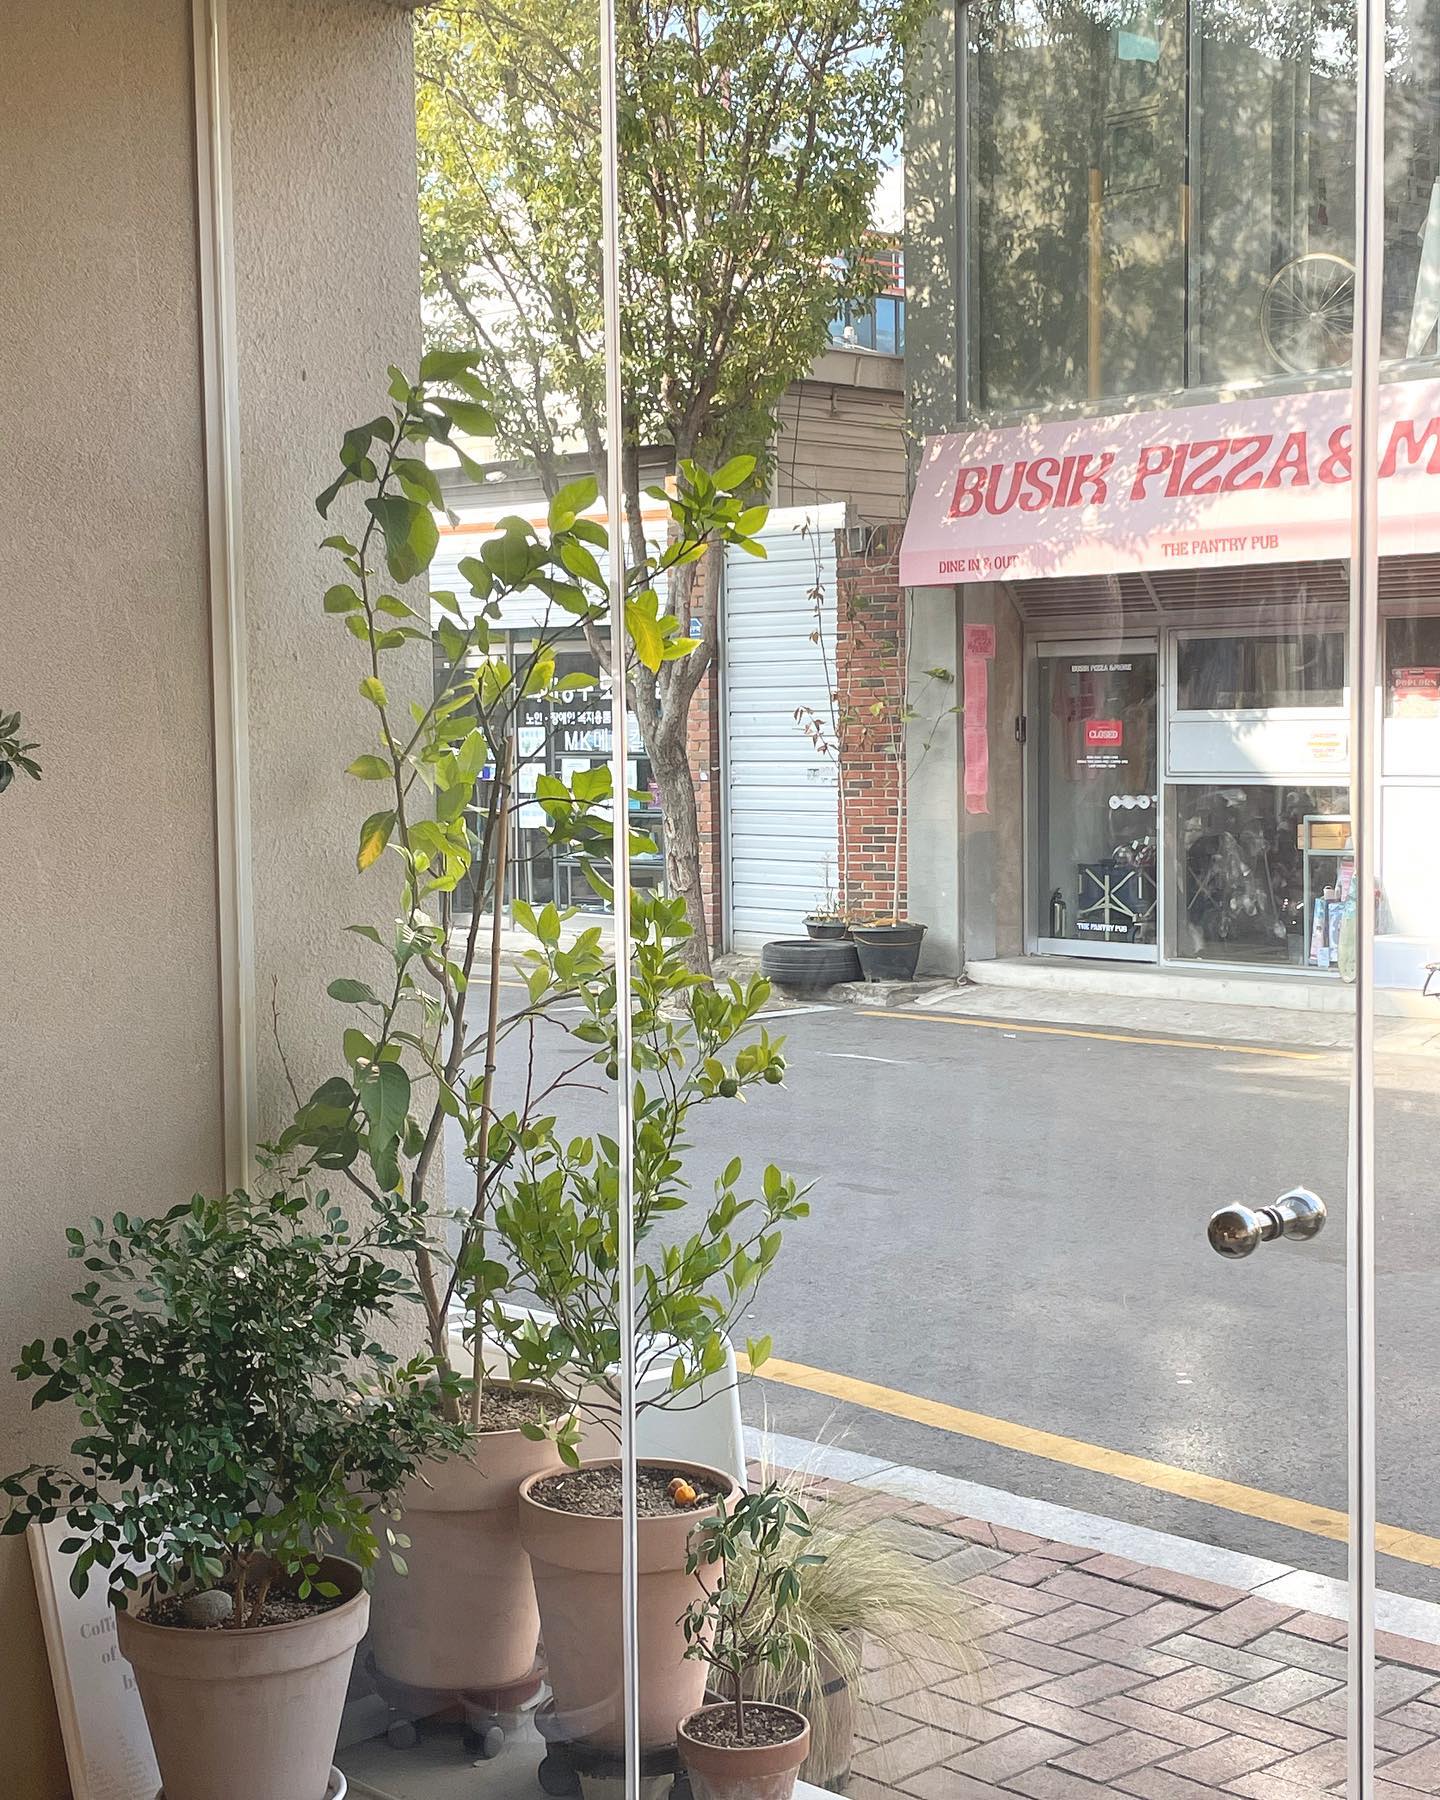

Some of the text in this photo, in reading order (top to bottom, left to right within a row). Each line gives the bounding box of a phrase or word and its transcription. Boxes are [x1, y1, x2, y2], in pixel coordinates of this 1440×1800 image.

[950, 453, 1115, 518] BUSIK
[1130, 431, 1310, 501] PIZZA
[1161, 534, 1279, 557] THE PANTRY PUB
[939, 559, 966, 574] DINE
[968, 558, 980, 572] IN
[994, 554, 1019, 570] OUT
[1076, 922, 1090, 930] THE
[102, 1644, 118, 1664] of
